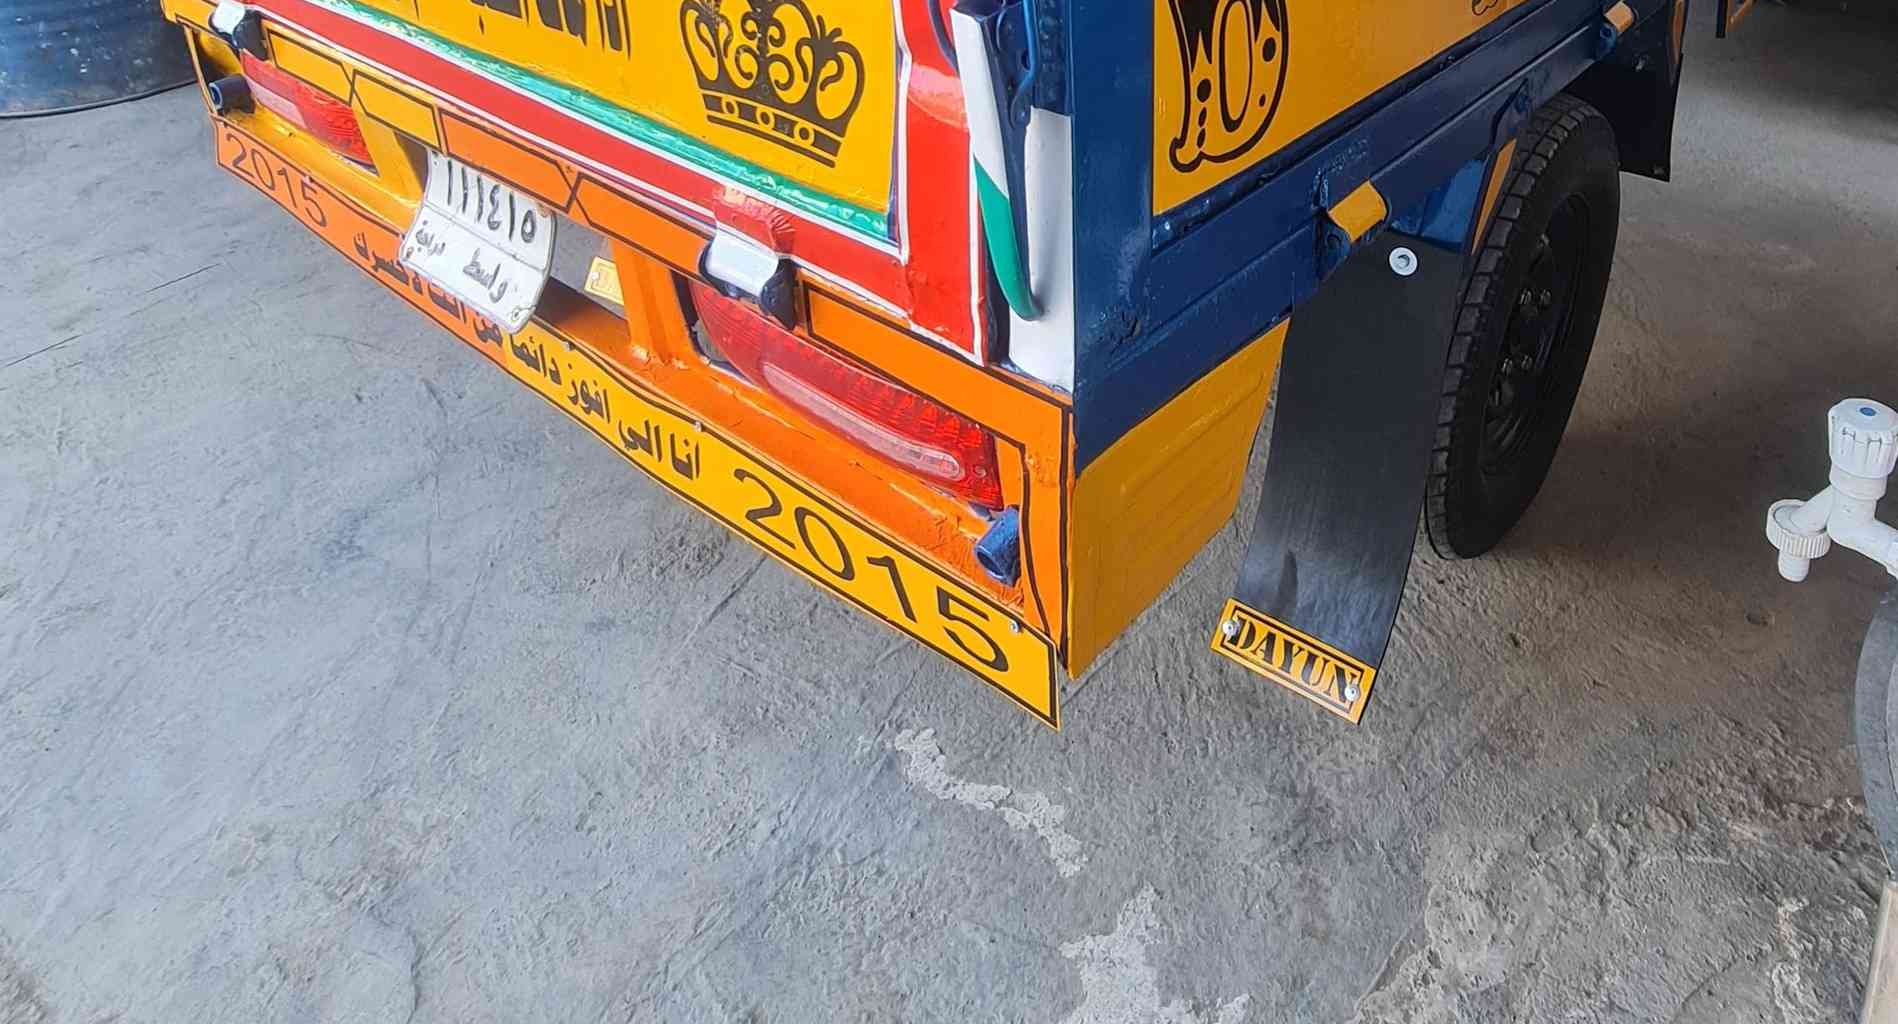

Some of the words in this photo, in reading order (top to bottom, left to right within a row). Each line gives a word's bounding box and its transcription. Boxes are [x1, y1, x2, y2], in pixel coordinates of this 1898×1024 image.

[225, 133, 328, 228] 2015
[462, 247, 508, 303] واسط
[670, 432, 700, 481] انا
[734, 467, 1009, 674] 2015
[1227, 614, 1356, 705] DAYUN
